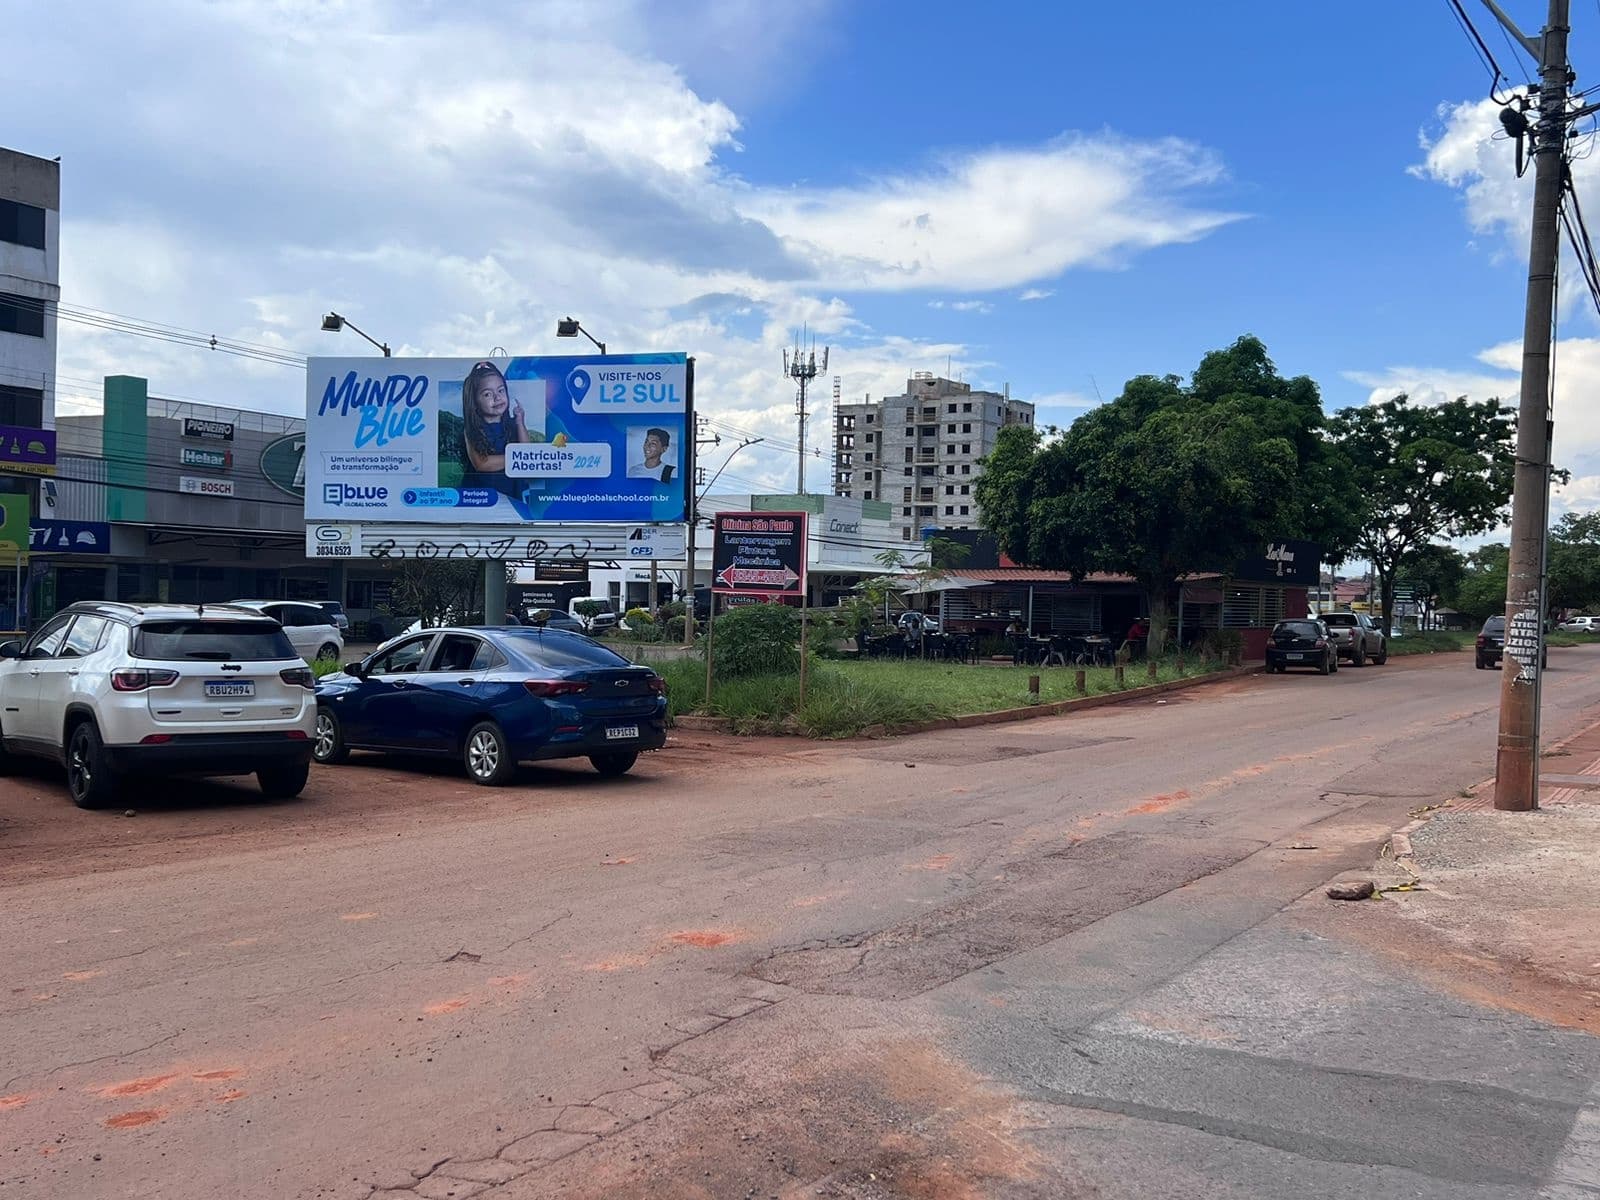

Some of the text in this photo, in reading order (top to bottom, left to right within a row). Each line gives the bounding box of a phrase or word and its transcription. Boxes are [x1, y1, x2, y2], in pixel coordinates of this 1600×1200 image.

[599, 371, 662, 381] VISITE-NOS
[599, 384, 680, 404] L2 SUL
[187, 420, 232, 435] PIONEIRO
[354, 402, 426, 449] Blue
[330, 455, 344, 463] Um
[345, 455, 379, 463] universo
[573, 455, 602, 469] 2024
[342, 464, 399, 472] transformação
[512, 460, 562, 471] Abertas!
[201, 482, 232, 494] BOSCH
[463, 497, 488, 505] Integral
[538, 493, 669, 503] www.blueglobalschool.com.br
[722, 518, 794, 532] Oficina São Paulo
[830, 518, 859, 534] Conect
[738, 546, 776, 556] Pintura
[732, 555, 781, 566] Mecânica
[220, 663, 242, 672] Jeep
[209, 685, 251, 695] RBU2H94
